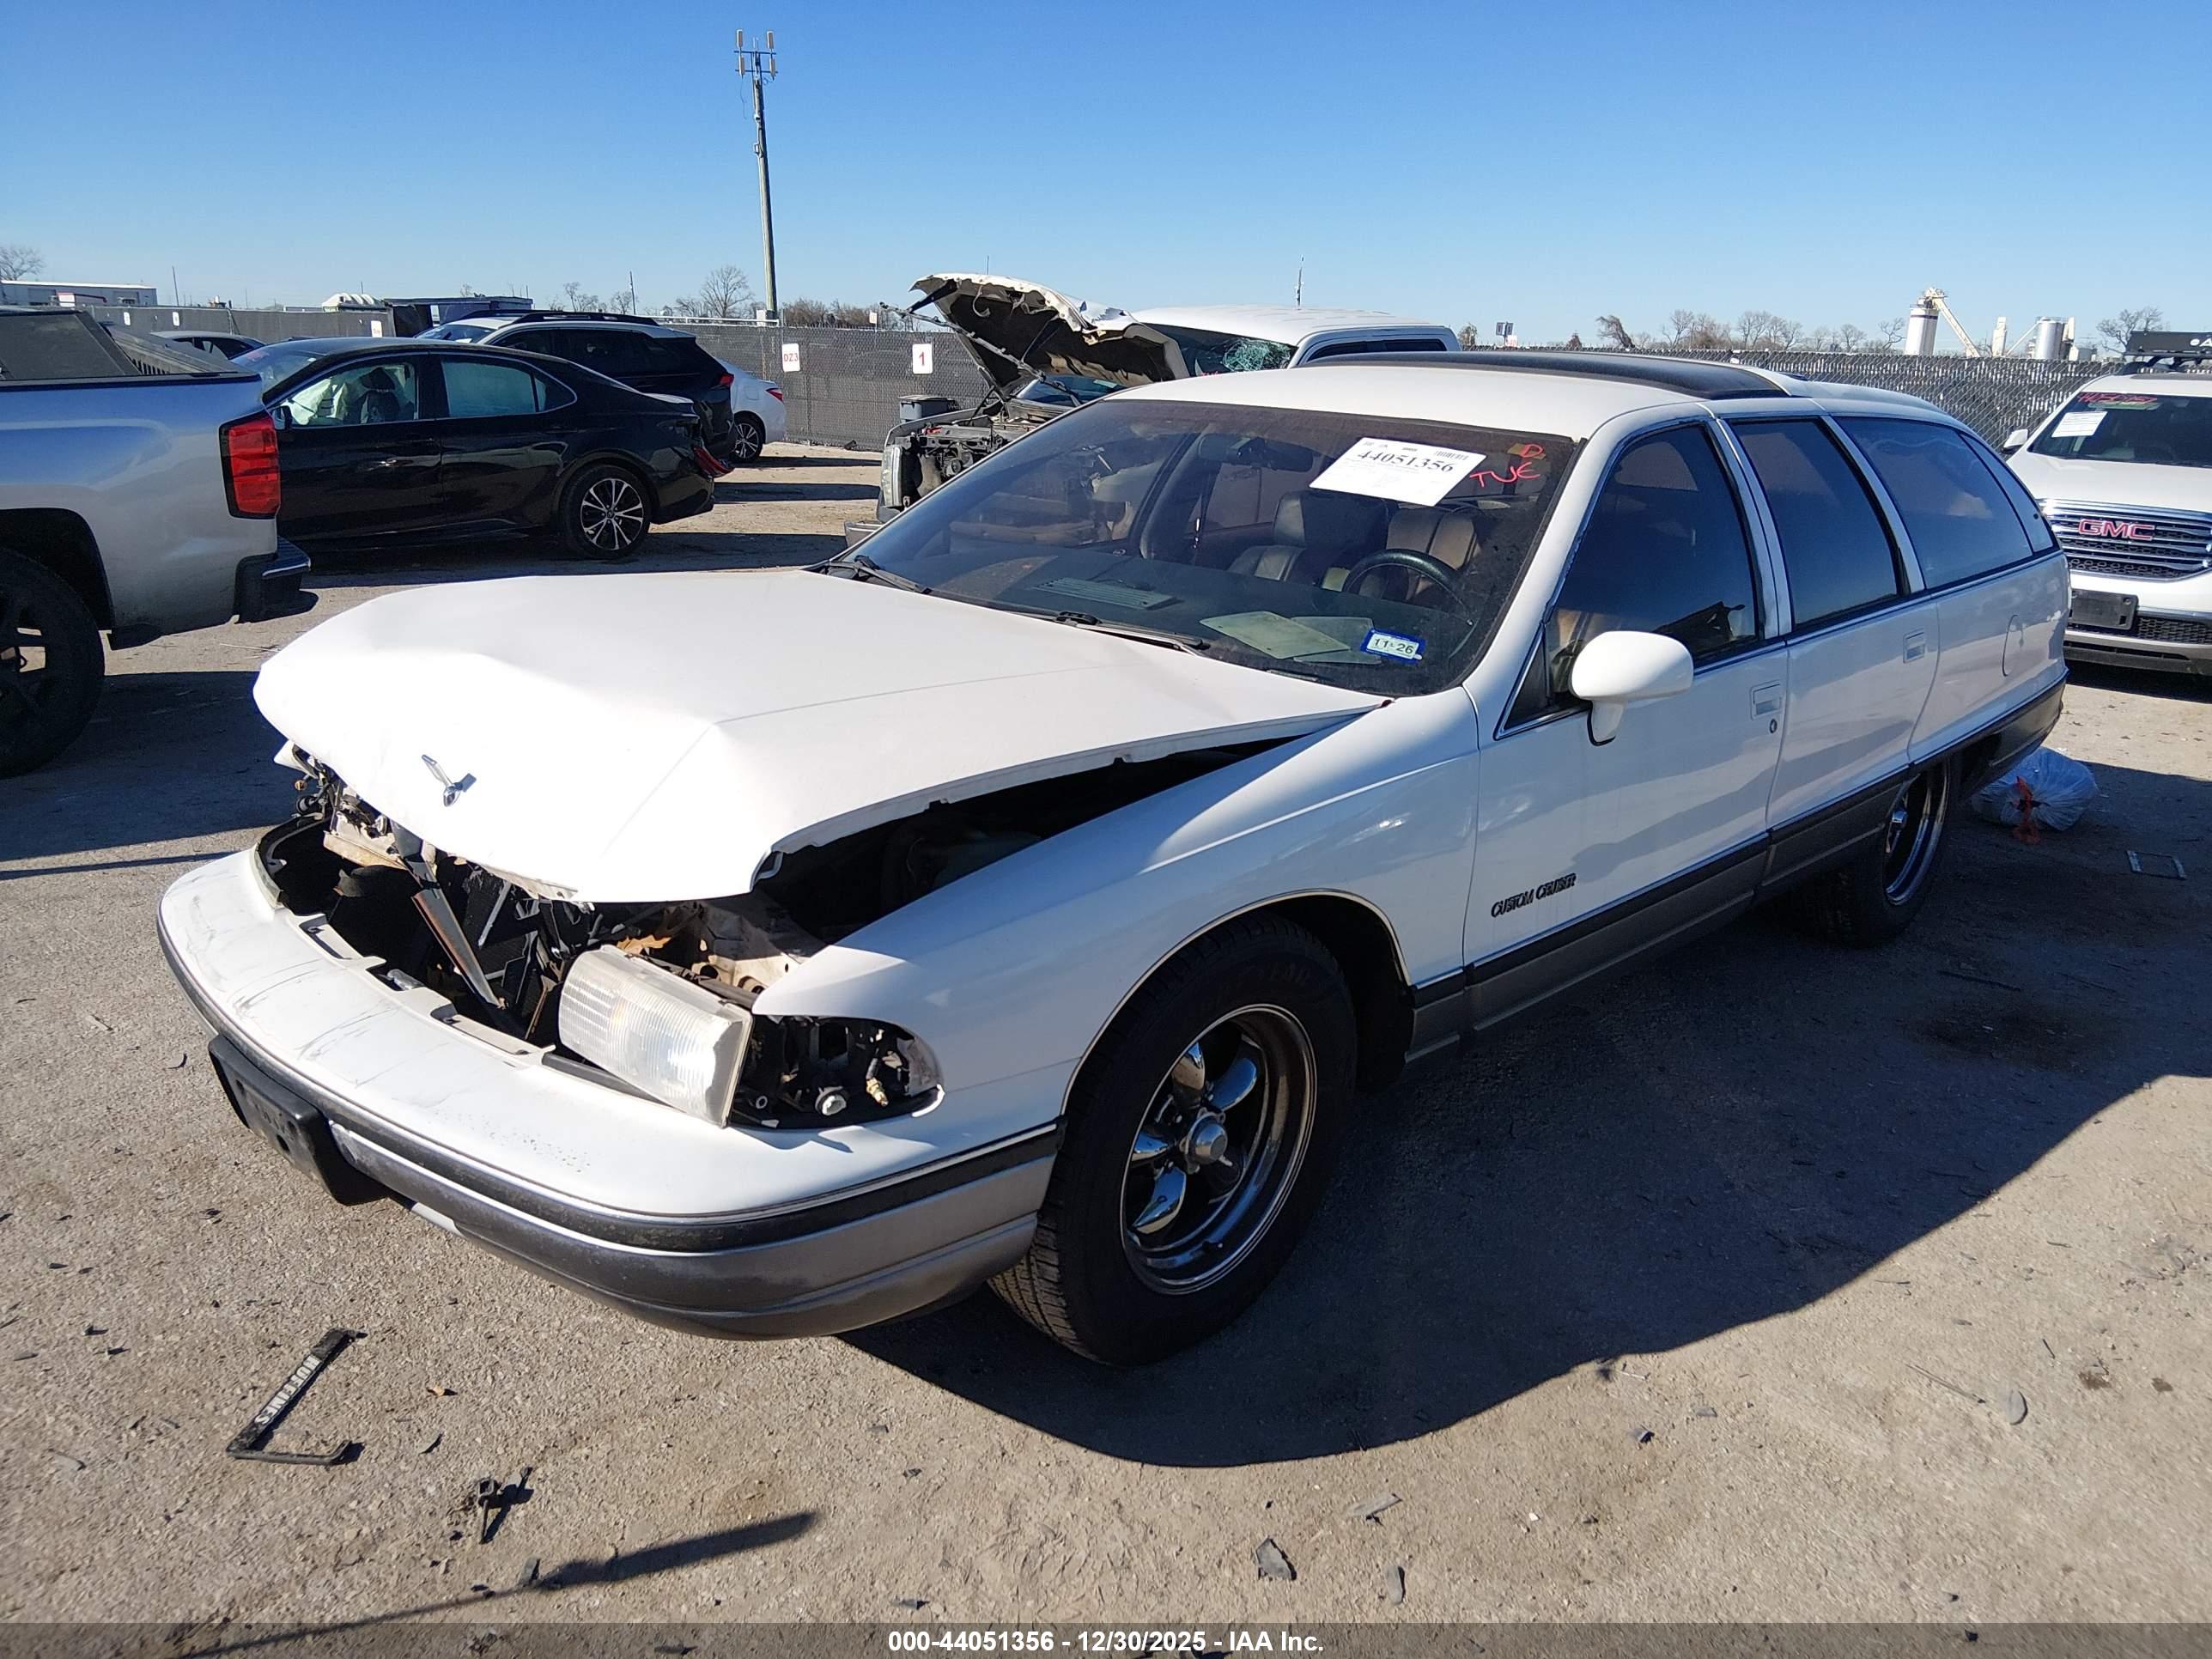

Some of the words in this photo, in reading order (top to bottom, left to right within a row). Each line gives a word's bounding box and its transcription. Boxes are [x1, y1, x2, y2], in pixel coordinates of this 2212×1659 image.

[919, 351, 926, 366] 1
[1358, 450, 1455, 473] 44051356
[1469, 461, 1540, 488] TUE
[2078, 519, 2154, 541] GMC
[1491, 888, 1534, 918] CUSTOM
[1535, 872, 1577, 900] CRUISER
[254, 1355, 321, 1425] HUFFINES
